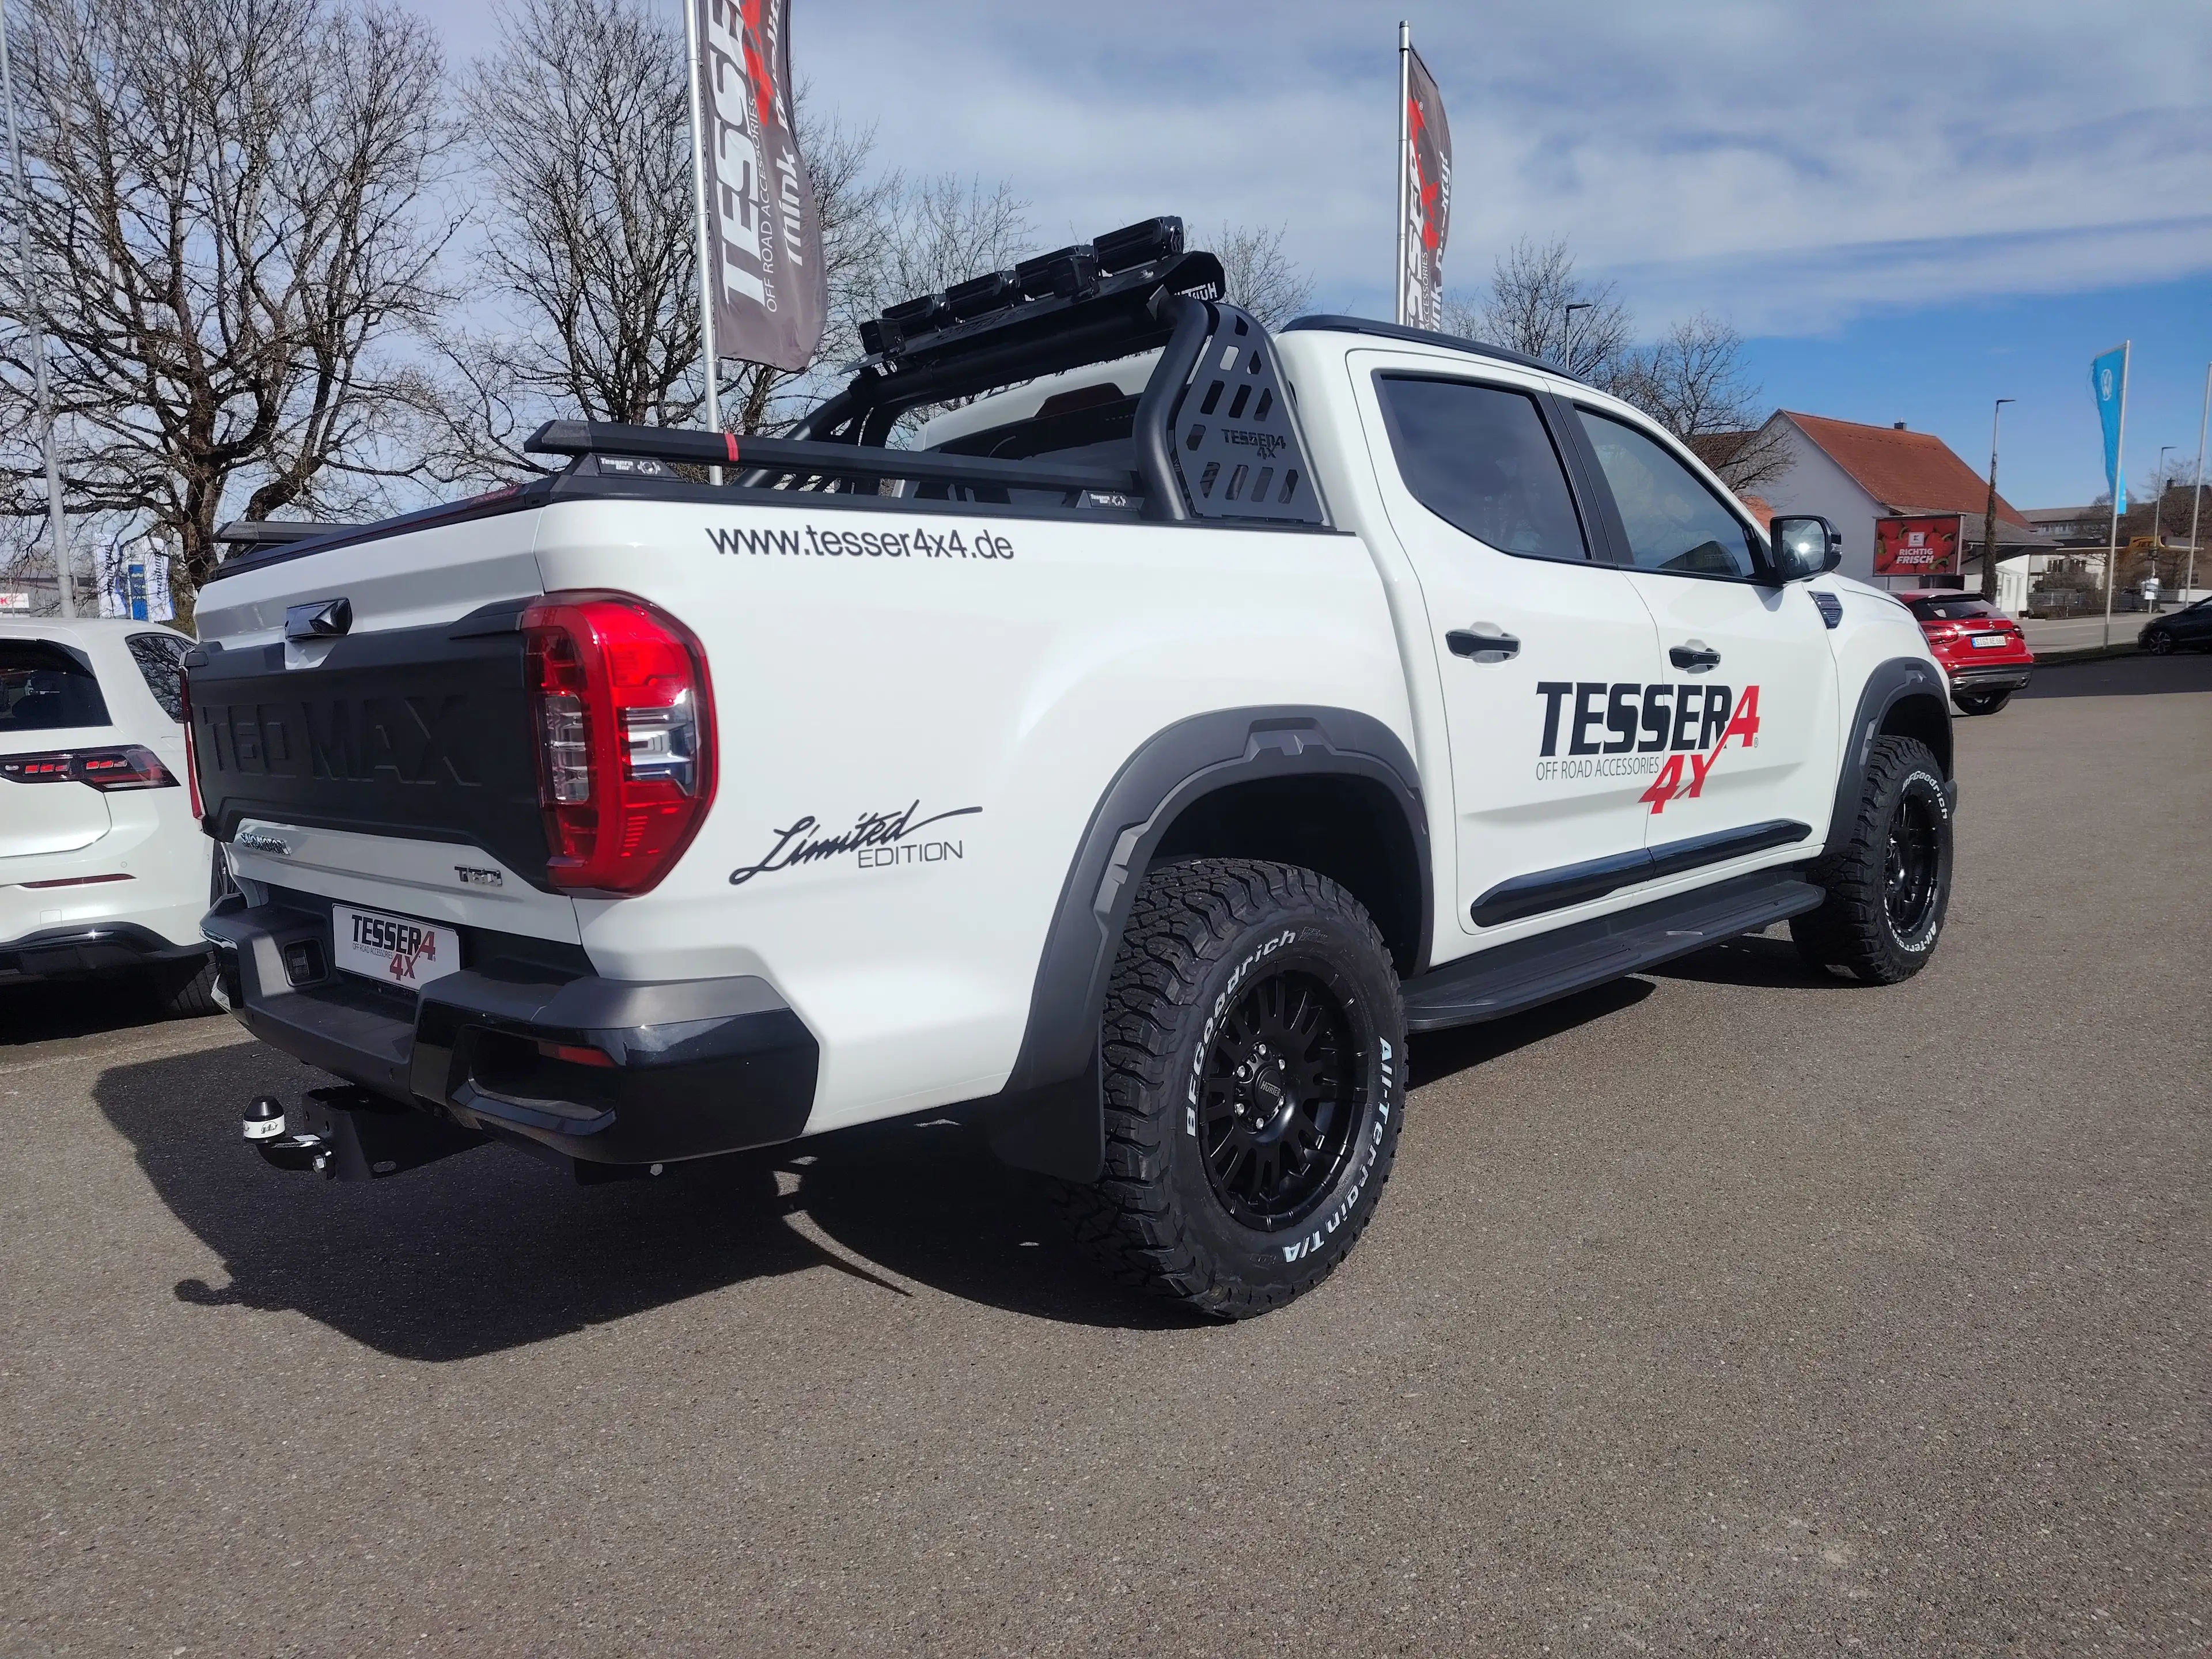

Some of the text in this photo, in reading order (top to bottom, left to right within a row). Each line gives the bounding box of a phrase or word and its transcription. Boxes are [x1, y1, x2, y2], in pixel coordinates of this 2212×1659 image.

[749, 97, 777, 312] OFF ROAD ACCESSORIES
[777, 145, 802, 266] Think
[705, 524, 1014, 561] www.tesser4x4.de
[1896, 555, 1934, 565] FRISCH
[301, 694, 483, 787] MAX
[1536, 756, 1660, 781] OFF ROAD ACCESSORIES
[729, 798, 983, 885] Limited
[858, 840, 964, 869] EDITION
[359, 944, 370, 954] ROAD
[370, 946, 393, 960] ACCESSORIES
[1187, 930, 1296, 1138] BFGoodrich
[1260, 1080, 1281, 1097] HURTER
[1282, 1036, 1393, 1263] All-Terrain T/A
